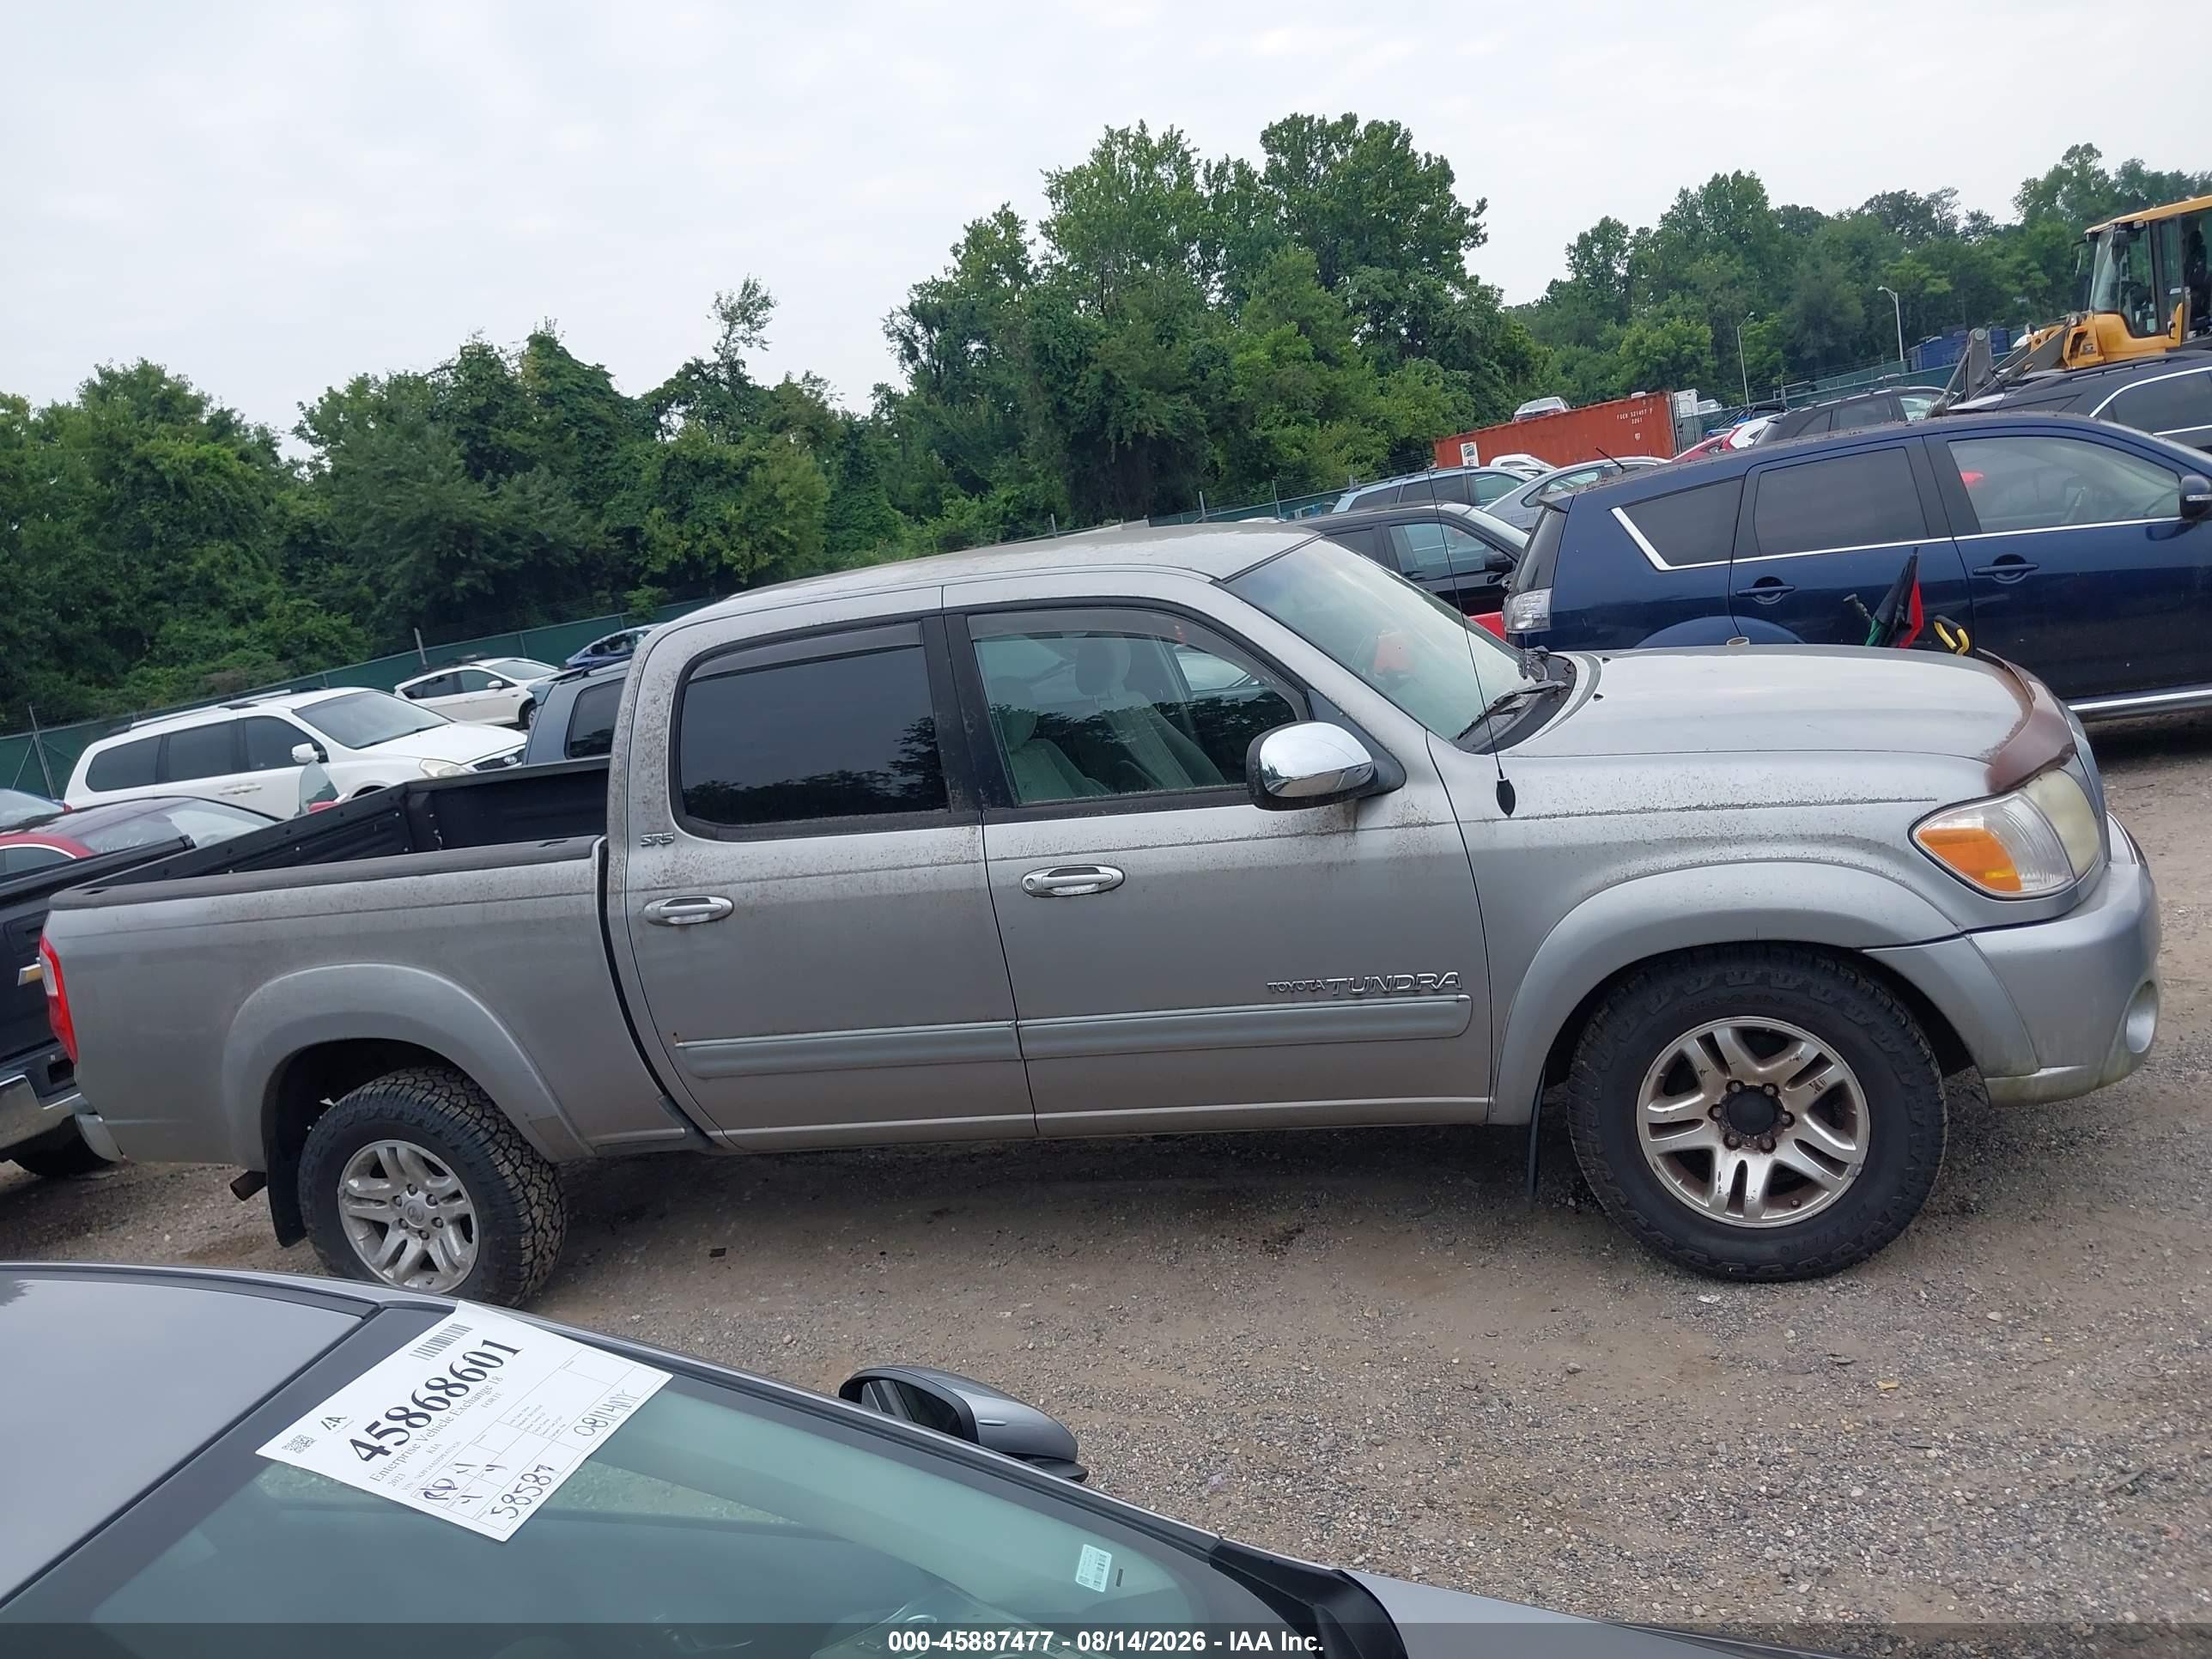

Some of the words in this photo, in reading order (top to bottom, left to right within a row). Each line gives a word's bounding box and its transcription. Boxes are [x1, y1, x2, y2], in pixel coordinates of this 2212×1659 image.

[640, 831, 674, 847] SR5
[1267, 979, 1327, 994] TOYOTA
[1327, 971, 1462, 995] TUNDRA
[349, 1339, 524, 1462] 45868601
[370, 1443, 421, 1482] Enterprise
[415, 1415, 454, 1441] Vehicle
[449, 1385, 493, 1416] Exchange
[488, 1376, 503, 1384] 18
[426, 1443, 442, 1454] KIA
